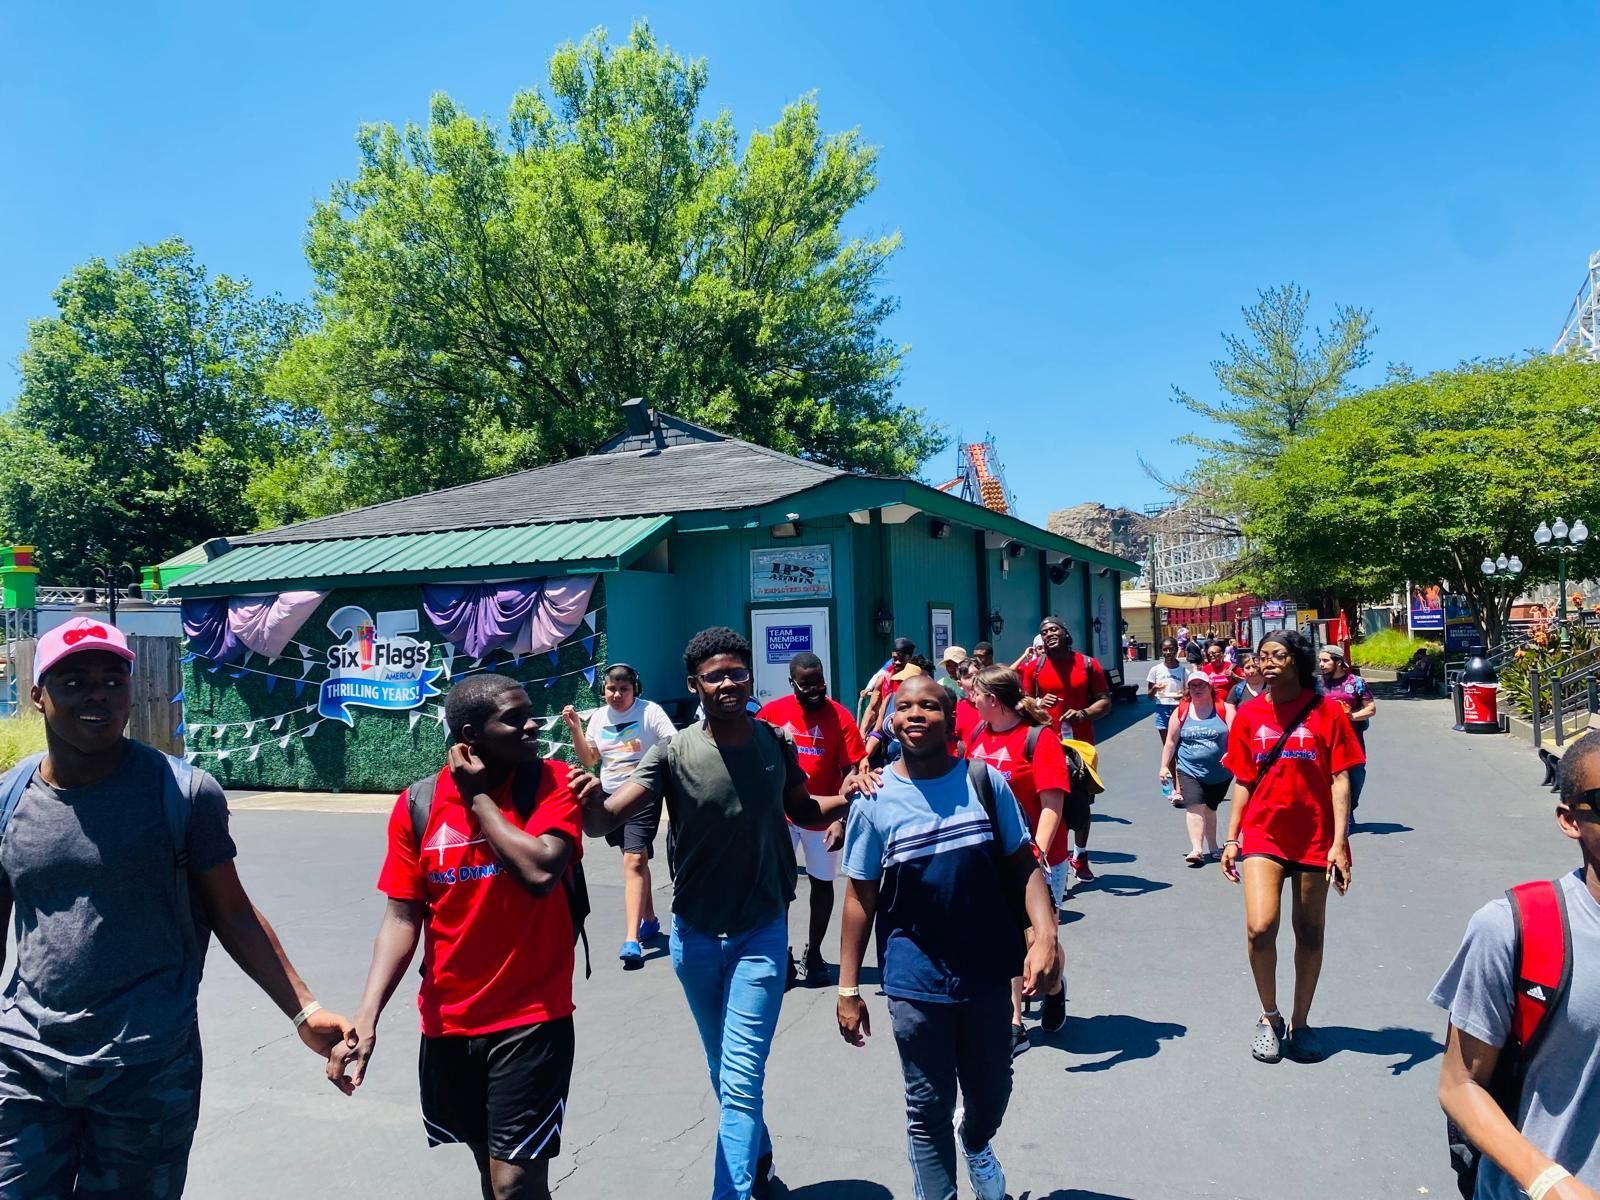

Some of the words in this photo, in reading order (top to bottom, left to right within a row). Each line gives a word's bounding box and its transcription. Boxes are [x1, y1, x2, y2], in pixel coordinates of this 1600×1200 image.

[771, 562, 815, 578] IPS
[769, 629, 793, 637] TEAM
[769, 635, 809, 643] MEMBERS
[769, 642, 791, 650] ONLY
[328, 646, 359, 669] Six
[375, 643, 427, 669] Flags
[385, 671, 417, 680] AMERICA
[327, 683, 379, 699] THRILLING
[381, 685, 420, 701] YEARS!
